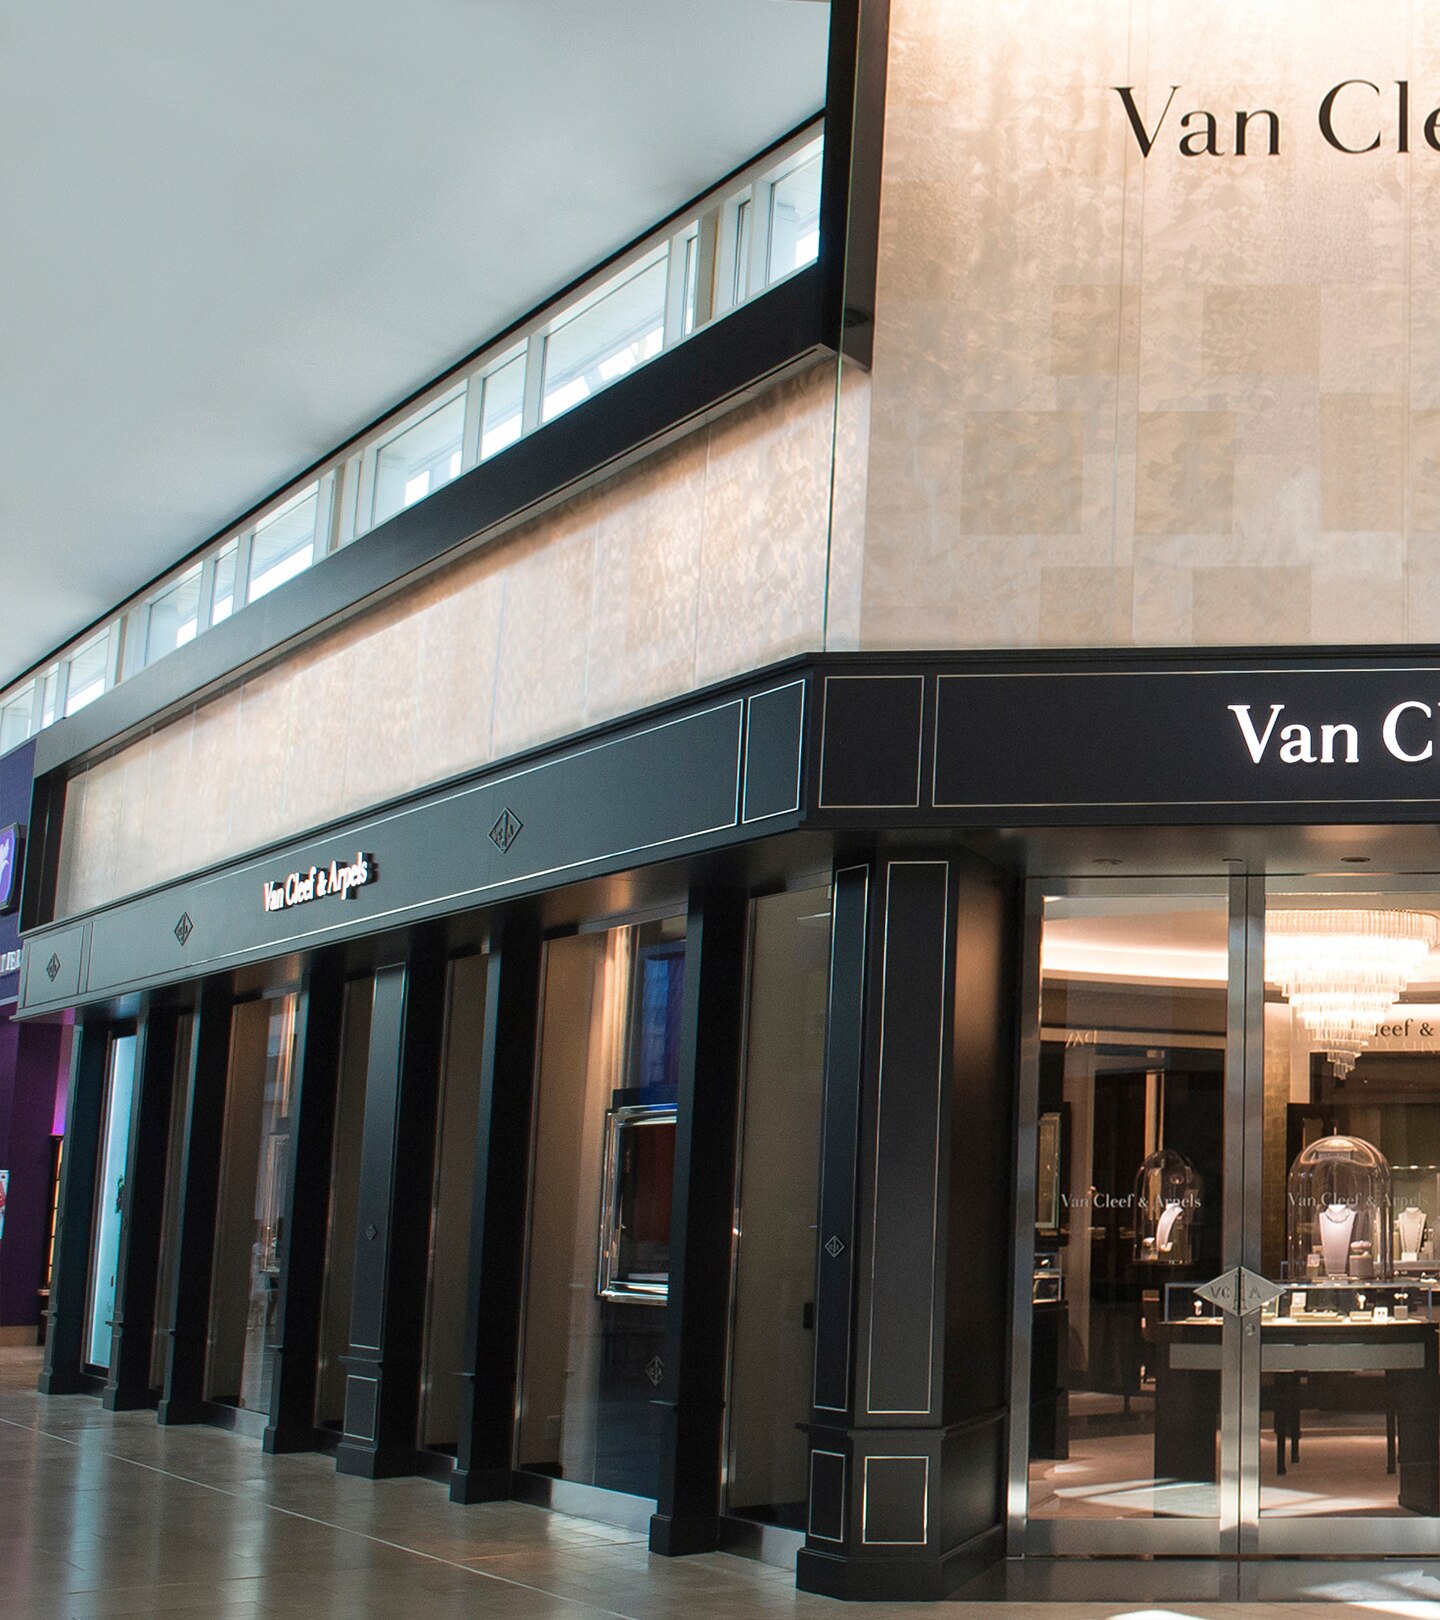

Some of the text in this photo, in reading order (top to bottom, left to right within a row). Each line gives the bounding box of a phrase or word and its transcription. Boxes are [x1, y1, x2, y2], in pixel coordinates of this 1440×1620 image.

[1112, 86, 1280, 159] Van
[1227, 704, 1360, 764] Van
[263, 851, 368, 912] Van Cleef & Arpels
[1374, 1017, 1414, 1037] leef
[1419, 1021, 1434, 1037] &
[1061, 1193, 1089, 1208] Van
[1093, 1193, 1135, 1208] Cleef
[1138, 1196, 1149, 1208] &
[1288, 1192, 1316, 1206] Van
[1321, 1192, 1362, 1206] Cleef
